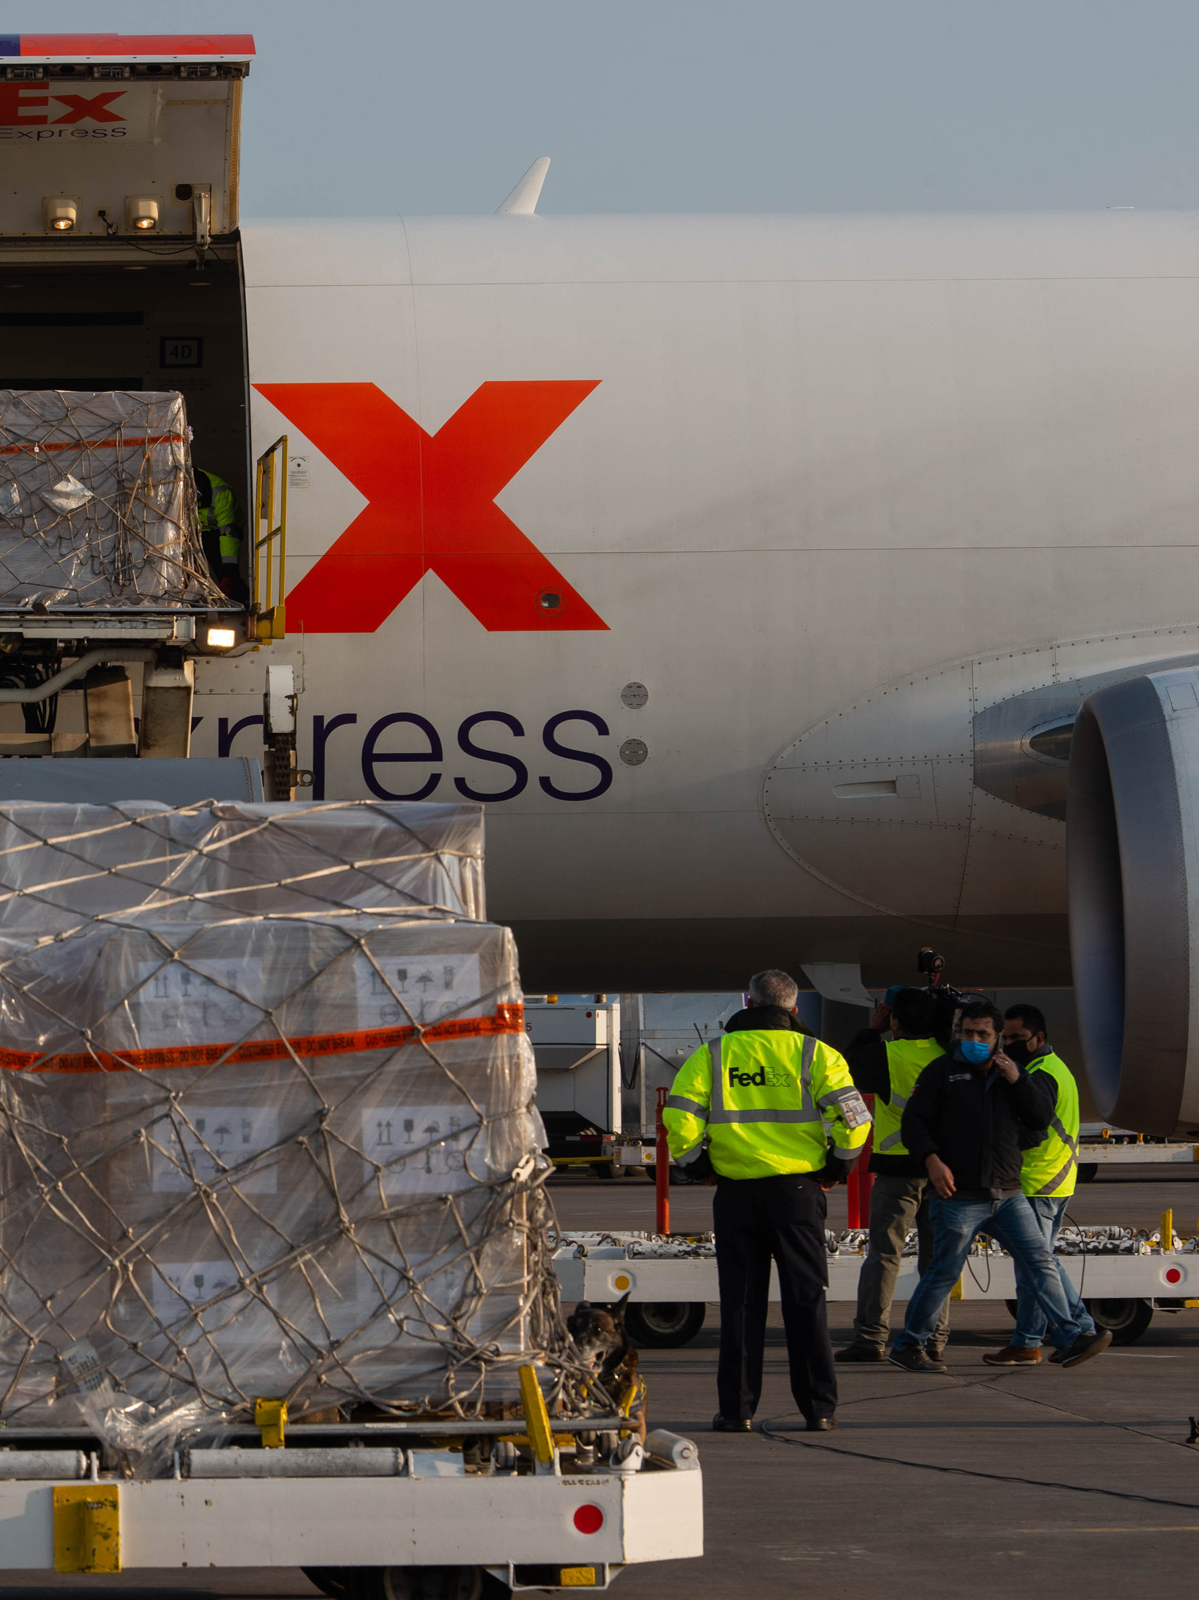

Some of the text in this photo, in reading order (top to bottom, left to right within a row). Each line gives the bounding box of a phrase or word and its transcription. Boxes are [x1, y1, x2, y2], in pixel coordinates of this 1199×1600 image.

[170, 344, 192, 359] 4D
[333, 1036, 356, 1050] BREAK
[728, 1066, 790, 1088] FedEx
